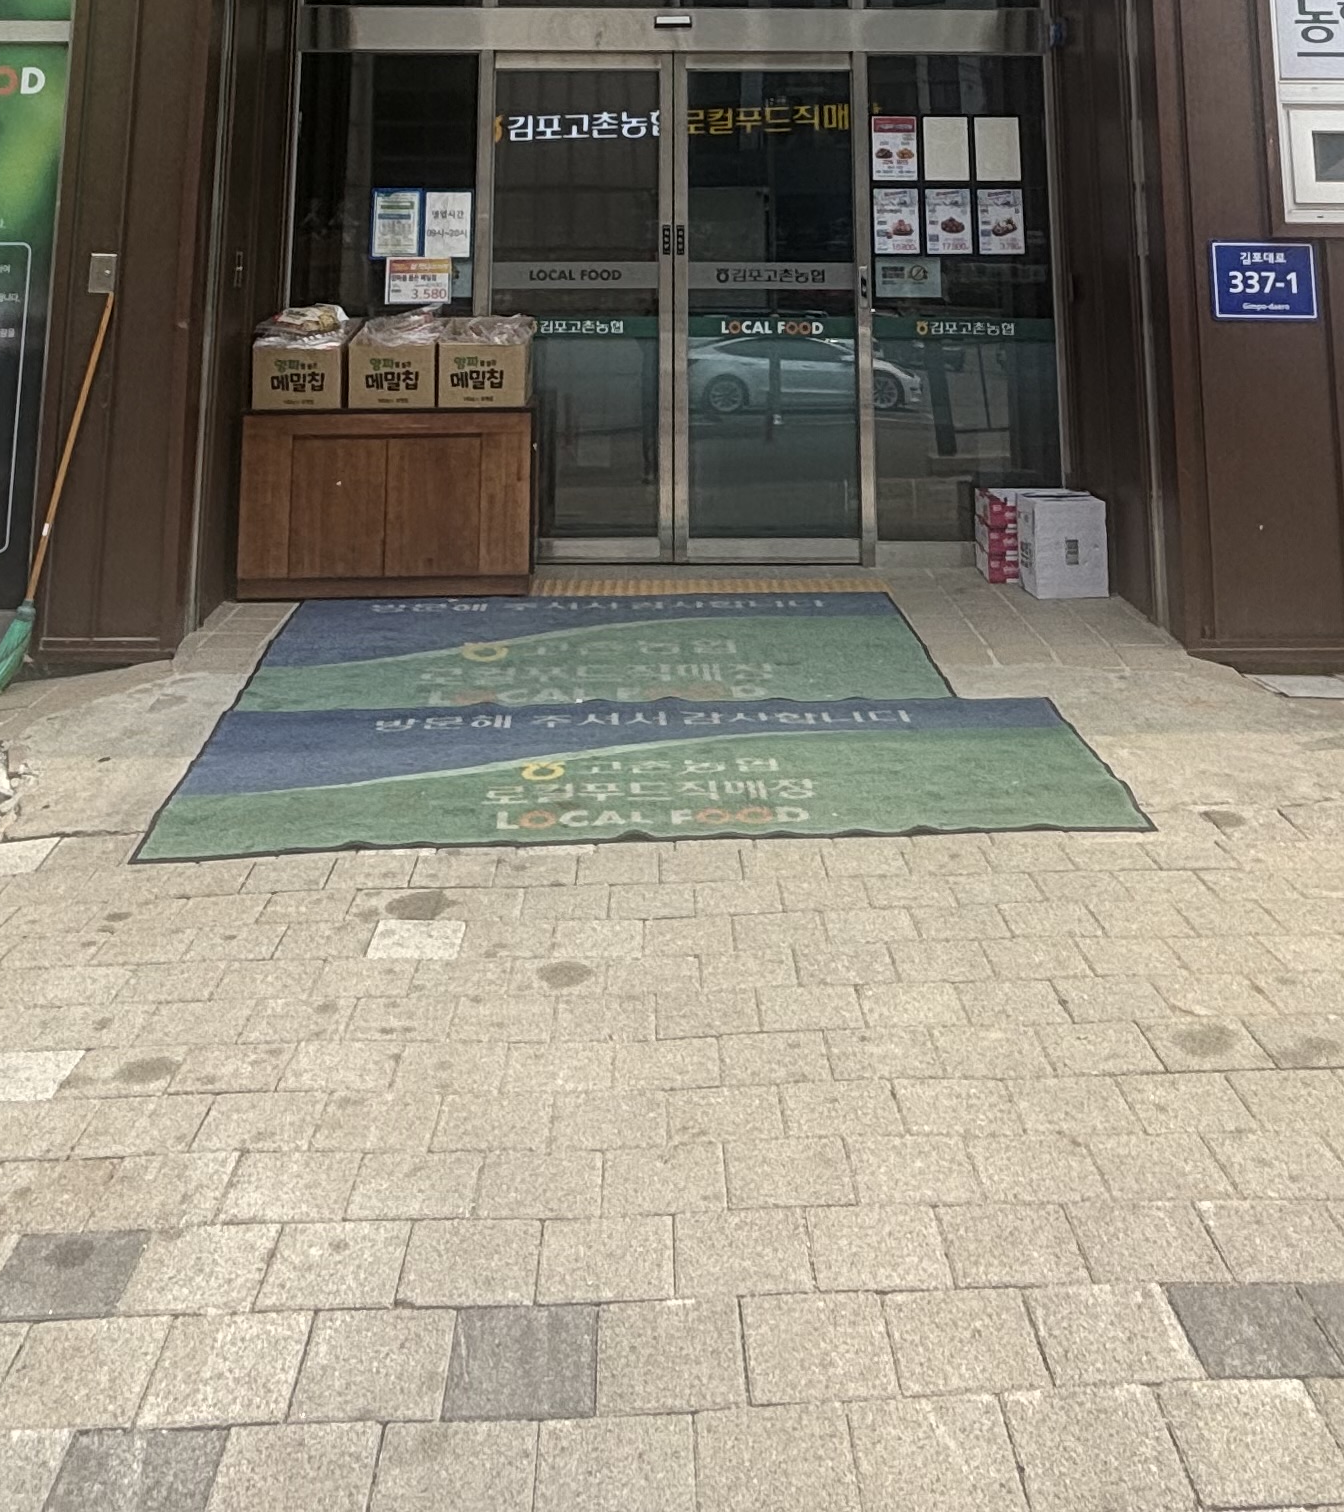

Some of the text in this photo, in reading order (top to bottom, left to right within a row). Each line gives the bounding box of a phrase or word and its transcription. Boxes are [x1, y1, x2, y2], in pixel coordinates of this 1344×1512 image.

[1239, 251, 1287, 264] 김포대로
[529, 269, 622, 282] LOCAL FOOD
[731, 268, 826, 284] 김포고촌농협
[1228, 270, 1299, 295] 337-1
[539, 320, 624, 335] 김포고촌농협
[721, 321, 824, 335] LOCAL FOOD
[930, 321, 1016, 337] 김포고촌농협
[270, 371, 325, 392] 메밀칩
[364, 370, 419, 392] 메밀칩
[449, 368, 505, 390] 메밀칩
[375, 715, 512, 732] 방문해
[684, 708, 911, 726] 감사합니다
[580, 757, 779, 775] 고촌농협
[481, 778, 816, 805] 로컬푸드직매장
[496, 806, 810, 830] LOCAL FOOD
